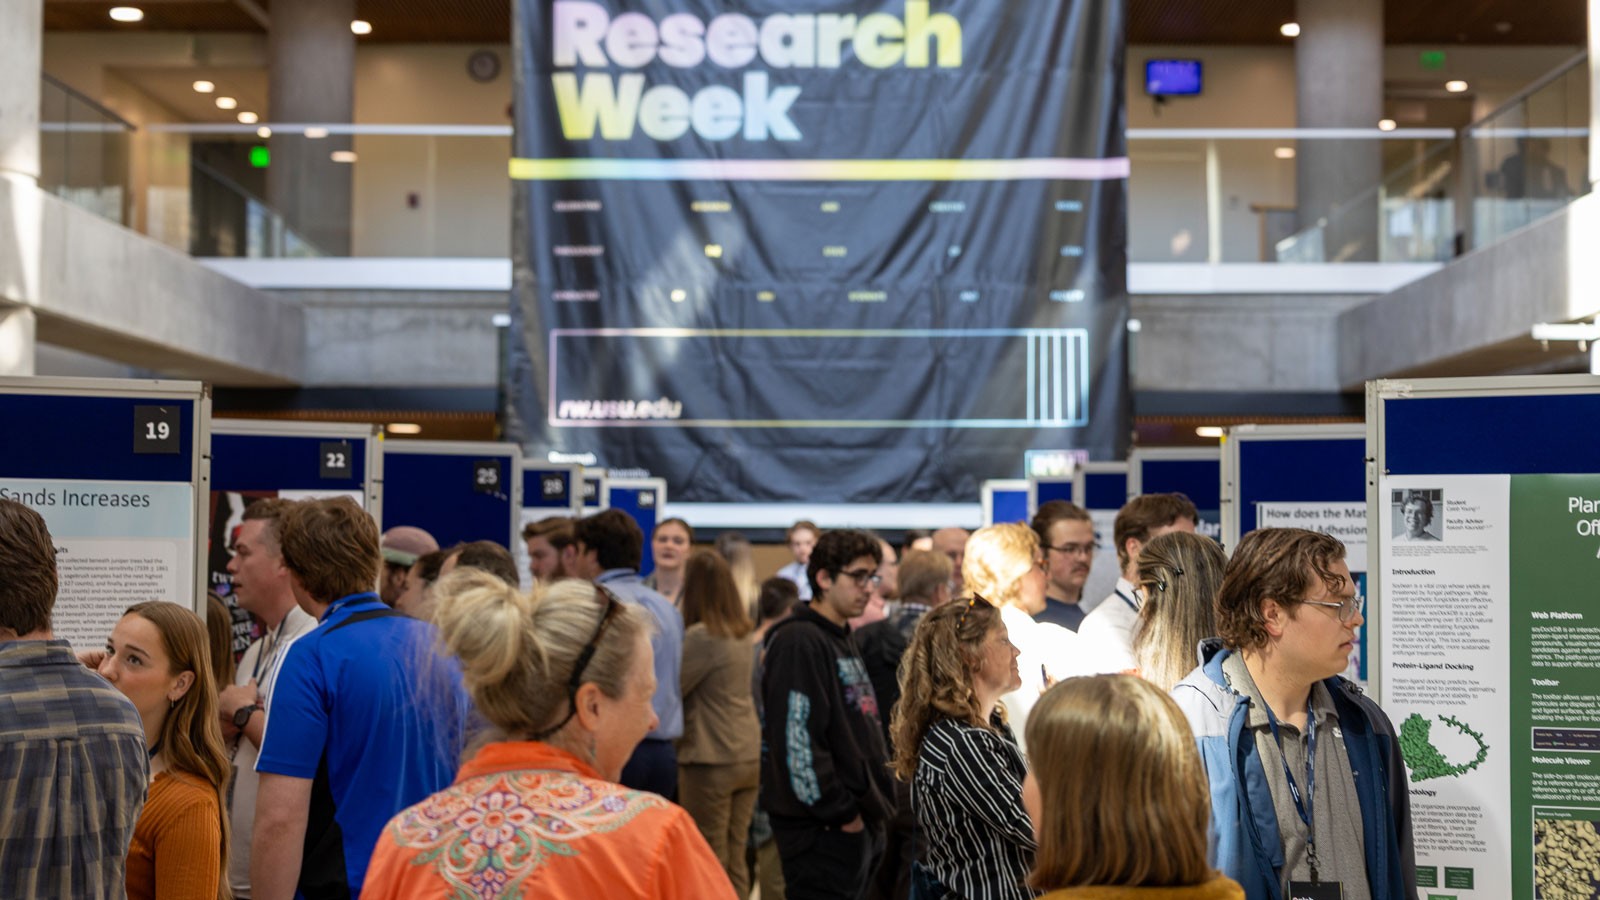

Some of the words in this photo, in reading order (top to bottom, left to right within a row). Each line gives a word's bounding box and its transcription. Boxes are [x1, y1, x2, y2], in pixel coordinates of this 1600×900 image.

[553, 0, 962, 67] Research
[552, 72, 801, 140] Week
[146, 422, 170, 440] 19
[326, 453, 346, 468] 22
[477, 467, 498, 485] 25
[63, 489, 150, 508] Increases
[1266, 510, 1292, 518] How
[1294, 509, 1320, 518] does
[1323, 510, 1341, 518] the
[1344, 509, 1367, 518] Mat
[1318, 525, 1367, 534] Adhesion
[1392, 662, 1443, 670] Protein-Ligand
